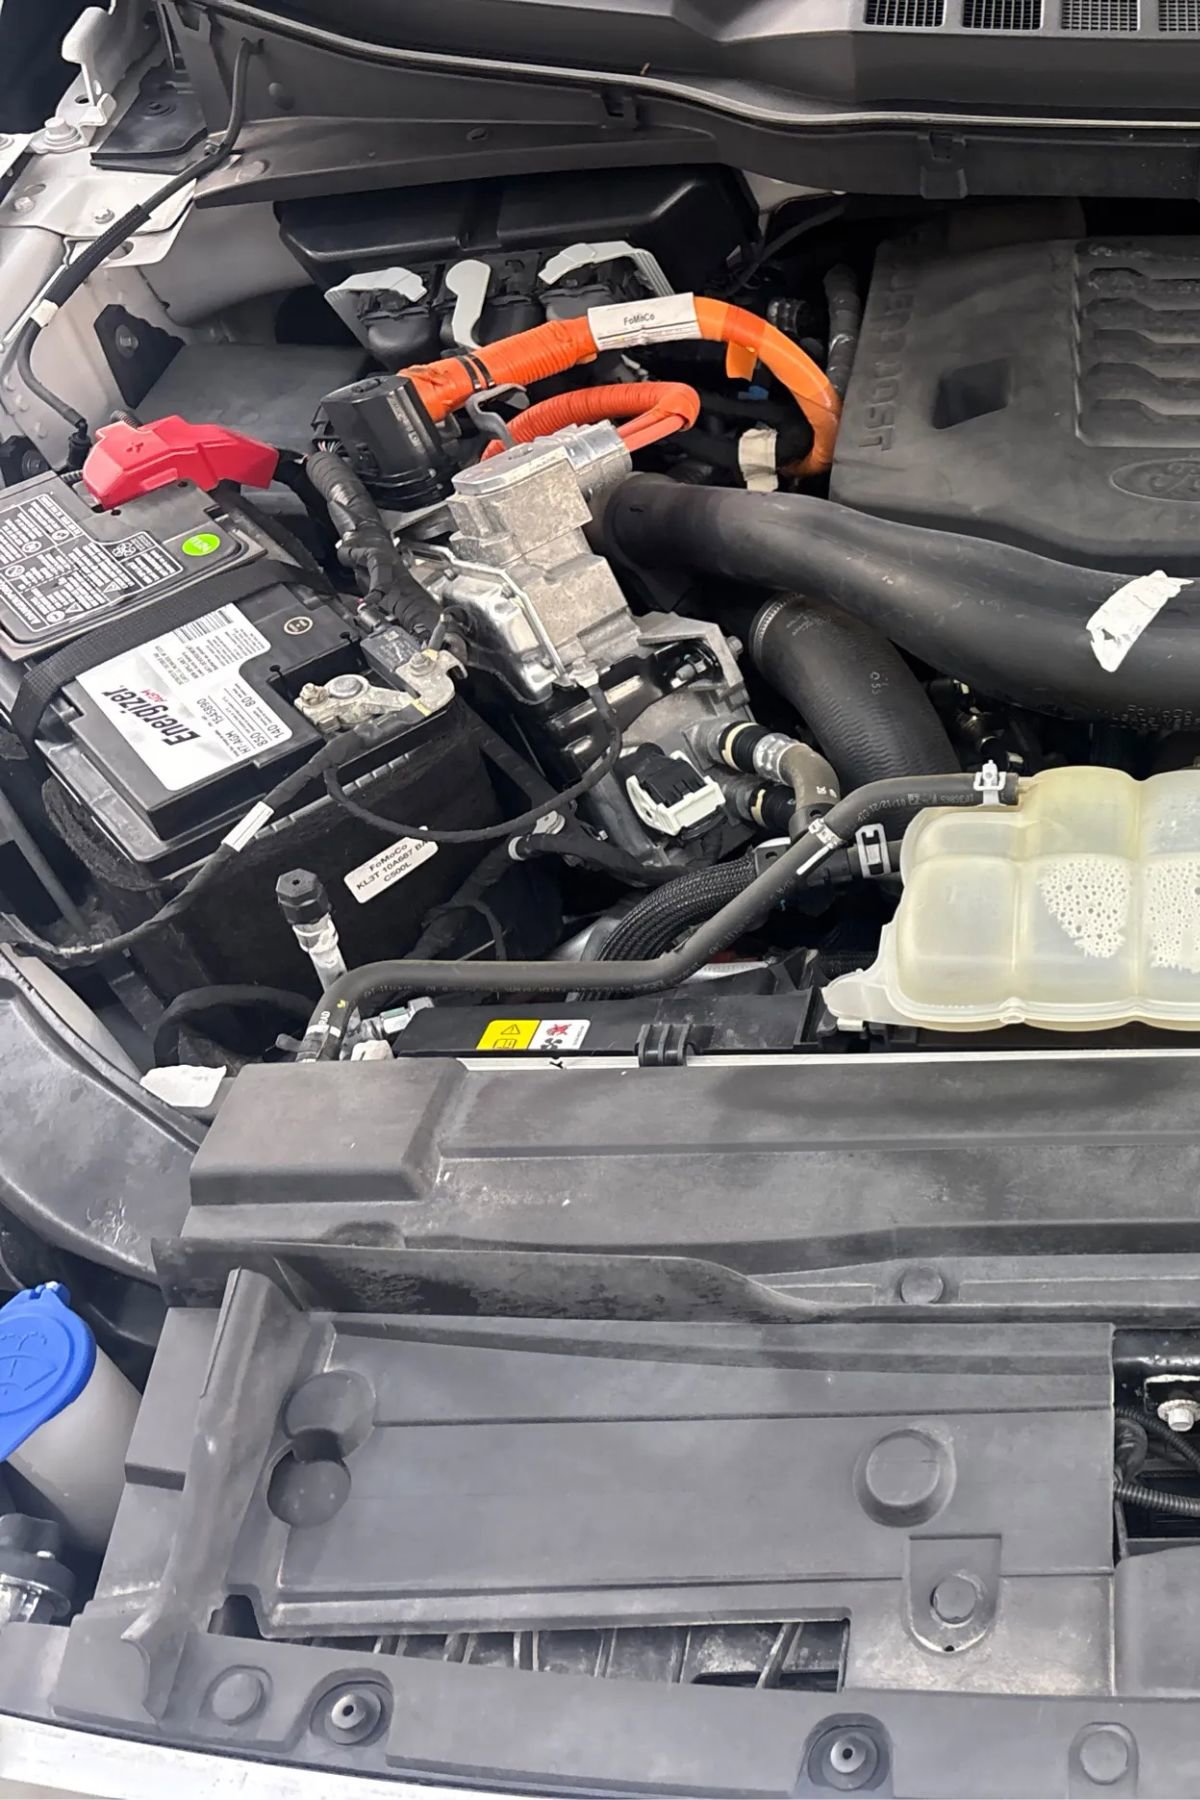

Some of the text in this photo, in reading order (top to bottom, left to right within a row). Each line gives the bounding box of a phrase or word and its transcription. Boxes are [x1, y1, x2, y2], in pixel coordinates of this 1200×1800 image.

[100, 687, 200, 747] Energizer
[239, 695, 285, 739] 140 80
[248, 731, 269, 747] 850
[356, 871, 380, 890] KL3T
[382, 849, 414, 873] 10A687
[369, 843, 408, 871] FoMoCo
[383, 862, 412, 882] C500L
